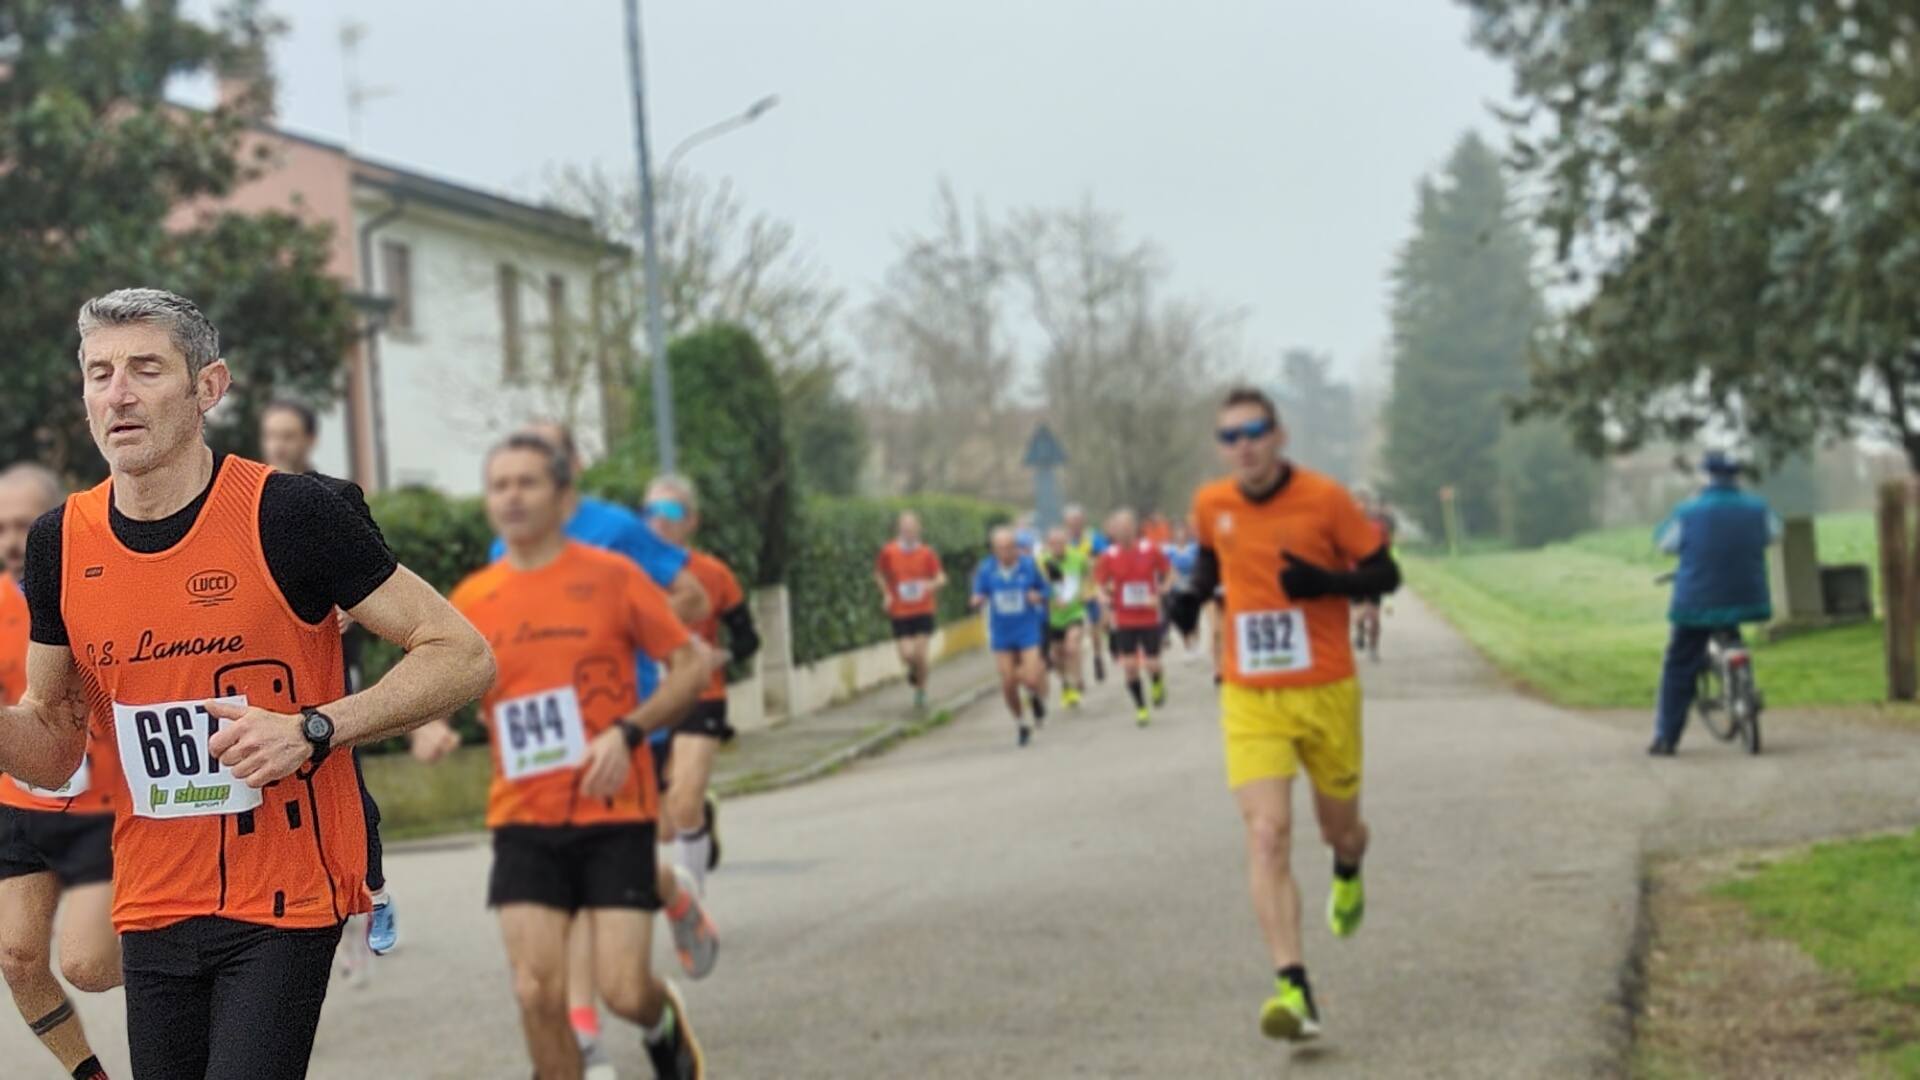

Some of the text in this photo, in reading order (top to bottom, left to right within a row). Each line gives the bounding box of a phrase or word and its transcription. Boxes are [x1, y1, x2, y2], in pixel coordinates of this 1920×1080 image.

[193, 576, 229, 592] LUCCI
[129, 629, 245, 663] Lamone
[1246, 612, 1294, 652] 692
[135, 706, 220, 778] 667
[506, 695, 565, 750] 644
